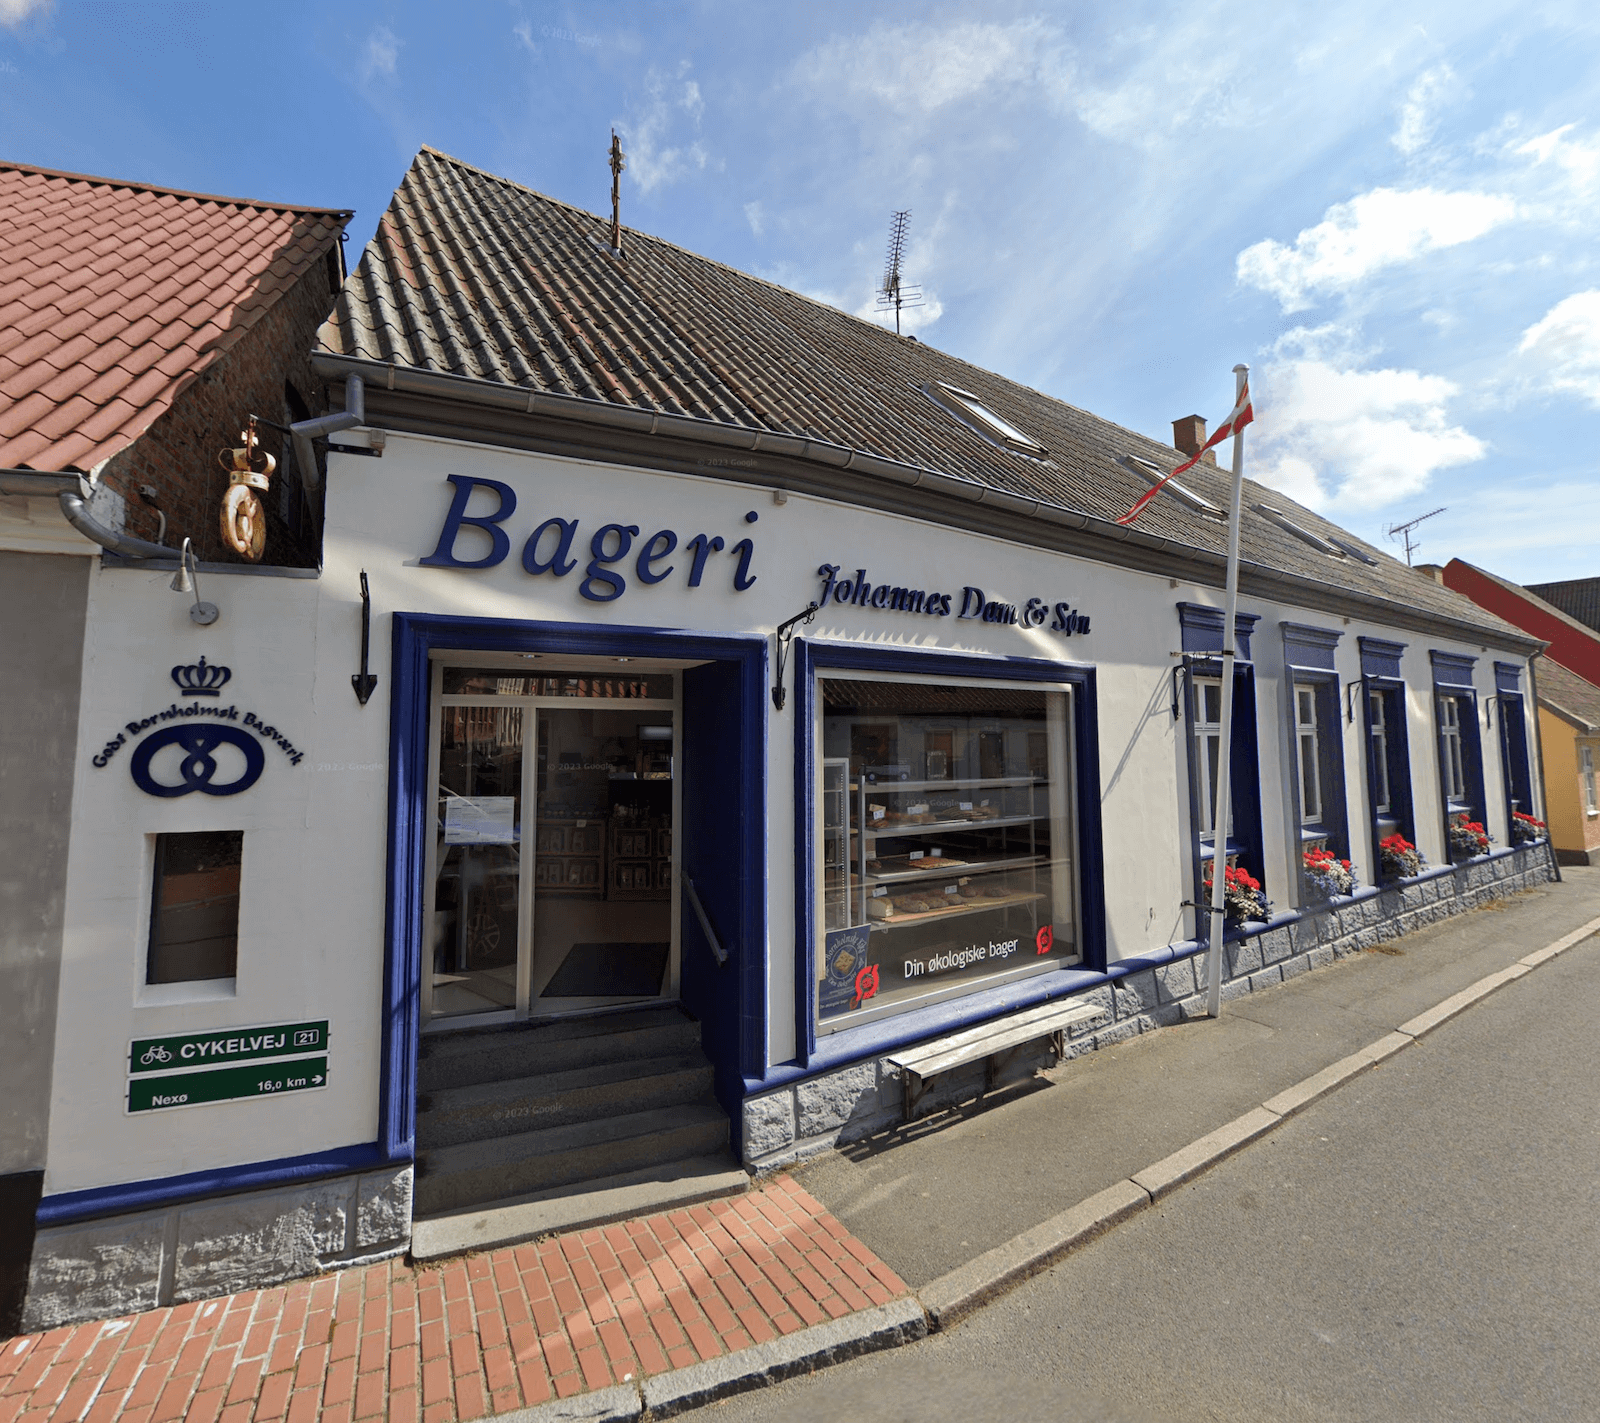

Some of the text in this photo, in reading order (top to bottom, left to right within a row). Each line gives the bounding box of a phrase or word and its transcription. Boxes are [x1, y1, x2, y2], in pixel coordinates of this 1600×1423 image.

[418, 474, 759, 602] Bageri
[811, 563, 1091, 638] Johannes Dam & Søn
[92, 702, 305, 768] Godt Bornholmsk Bagværk
[904, 938, 1019, 979] Din økologiske bager
[180, 1031, 315, 1059] CYKELVEJ 21
[151, 1076, 307, 1107] Nexø 16,0 km
